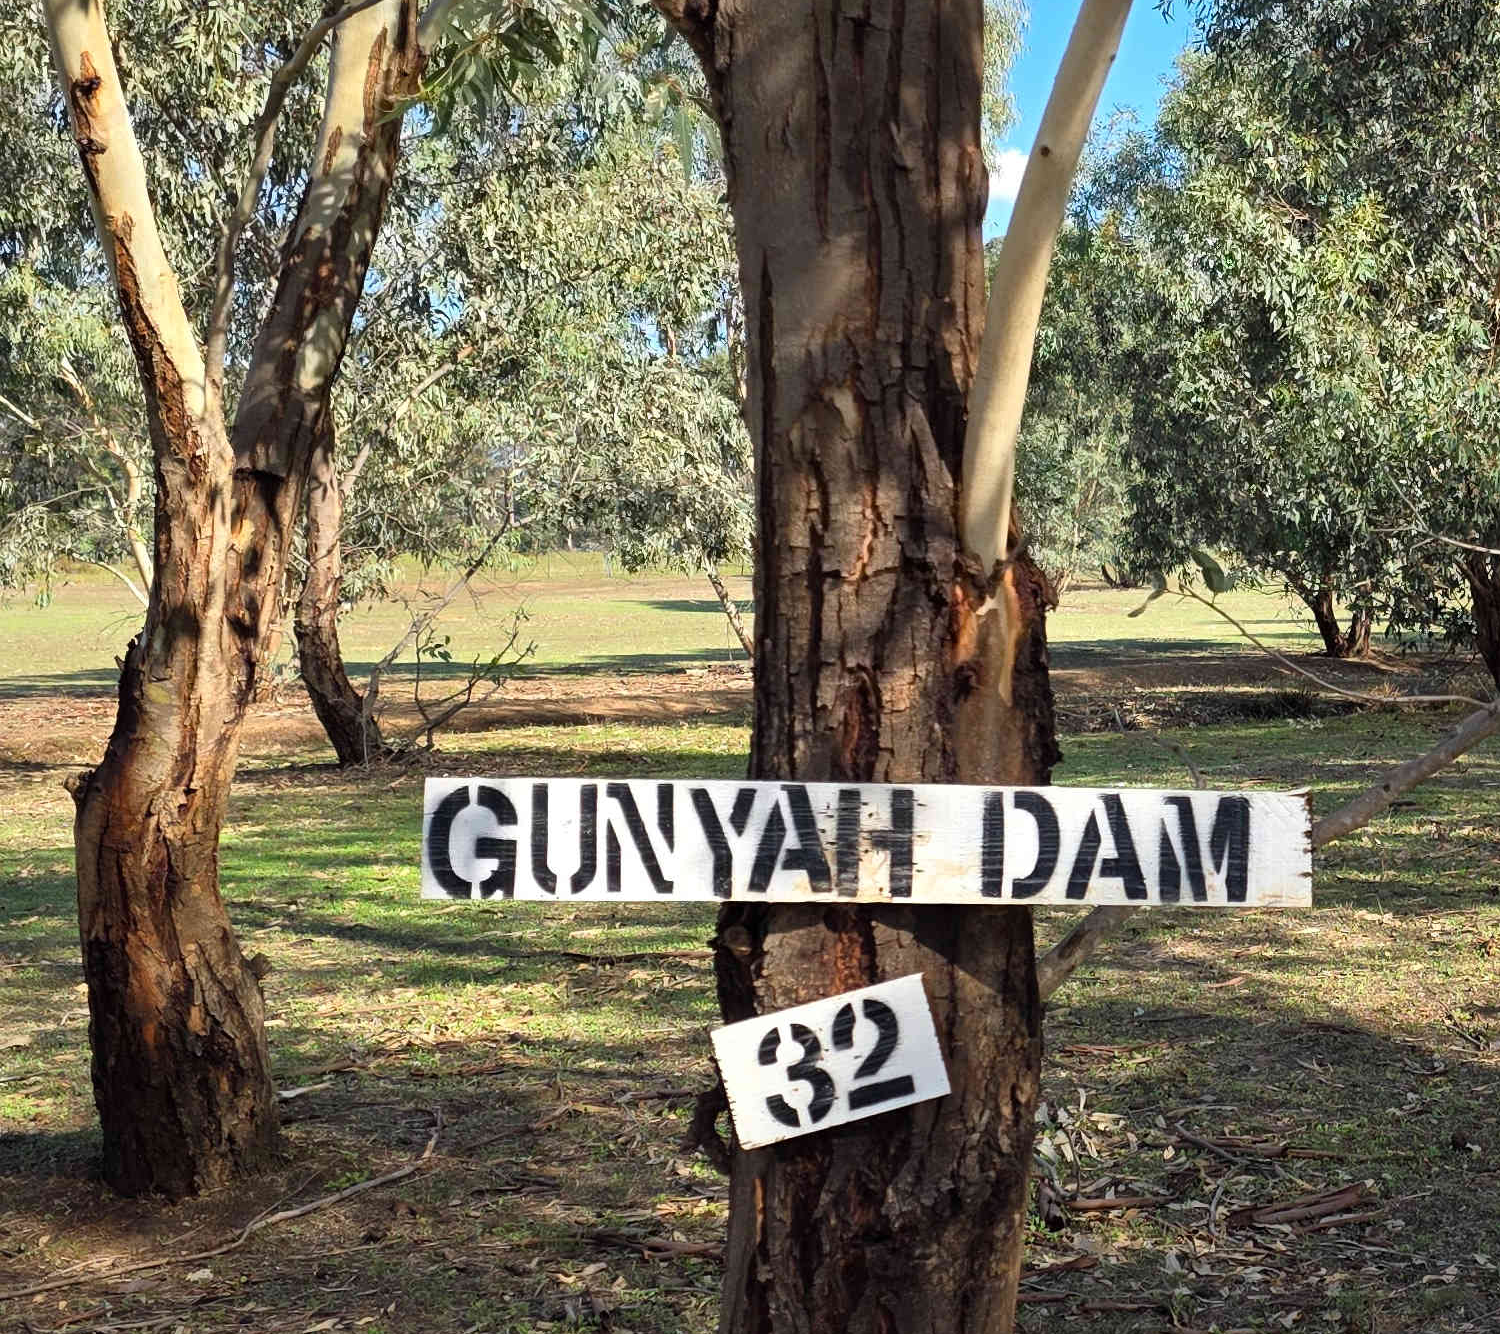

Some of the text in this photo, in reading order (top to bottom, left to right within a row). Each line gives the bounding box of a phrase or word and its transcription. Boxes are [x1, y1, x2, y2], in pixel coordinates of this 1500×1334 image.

[427, 783, 1251, 902] GUNYAH DAM
[757, 998, 916, 1128] 32
